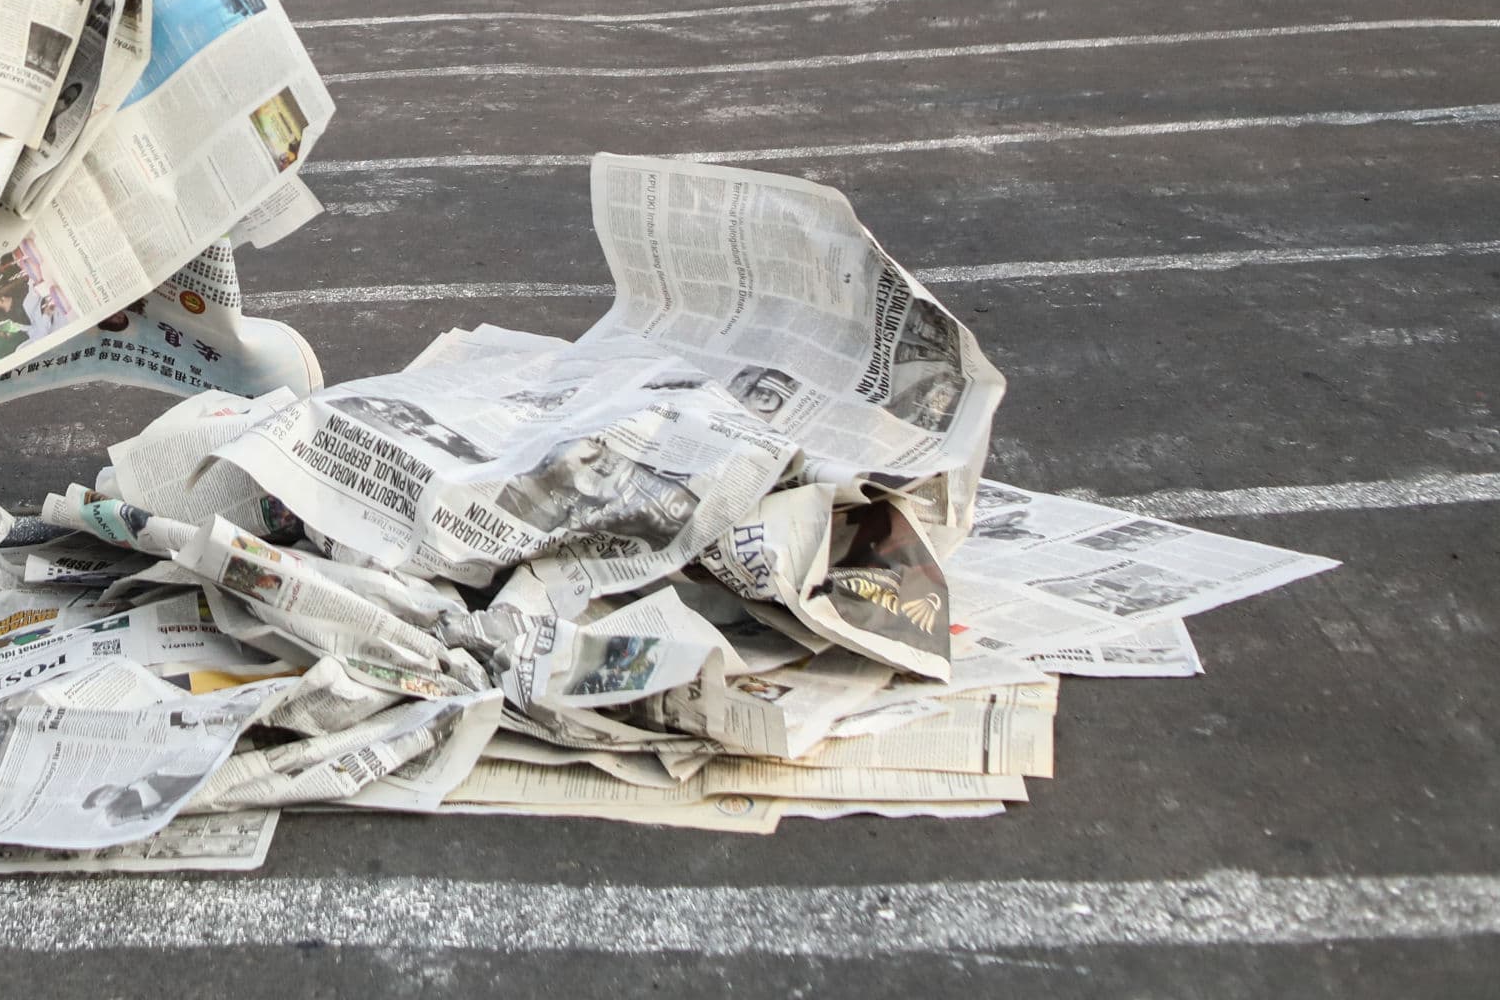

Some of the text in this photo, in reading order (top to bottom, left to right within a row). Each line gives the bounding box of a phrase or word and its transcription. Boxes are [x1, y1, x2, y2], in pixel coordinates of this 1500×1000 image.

[644, 173, 659, 191] KPU
[723, 181, 748, 217] Terminal
[644, 193, 657, 210] DKI
[879, 289, 909, 344] EVALUASI
[854, 350, 883, 397] BUATAN
[325, 412, 375, 450] PENIPUAN
[311, 429, 373, 473] BERPOTENSI
[372, 437, 434, 484] MUNCULKAN
[292, 438, 417, 522] PENCABUTAN MORATORIUM
[370, 459, 410, 491] PINJOL
[93, 504, 115, 538] MAKIN
[430, 505, 503, 556] KELUARKAN
[463, 500, 532, 548] AL-ZAYTUN
[14, 635, 65, 656] Selamat
[160, 638, 204, 652] POSKOTA
